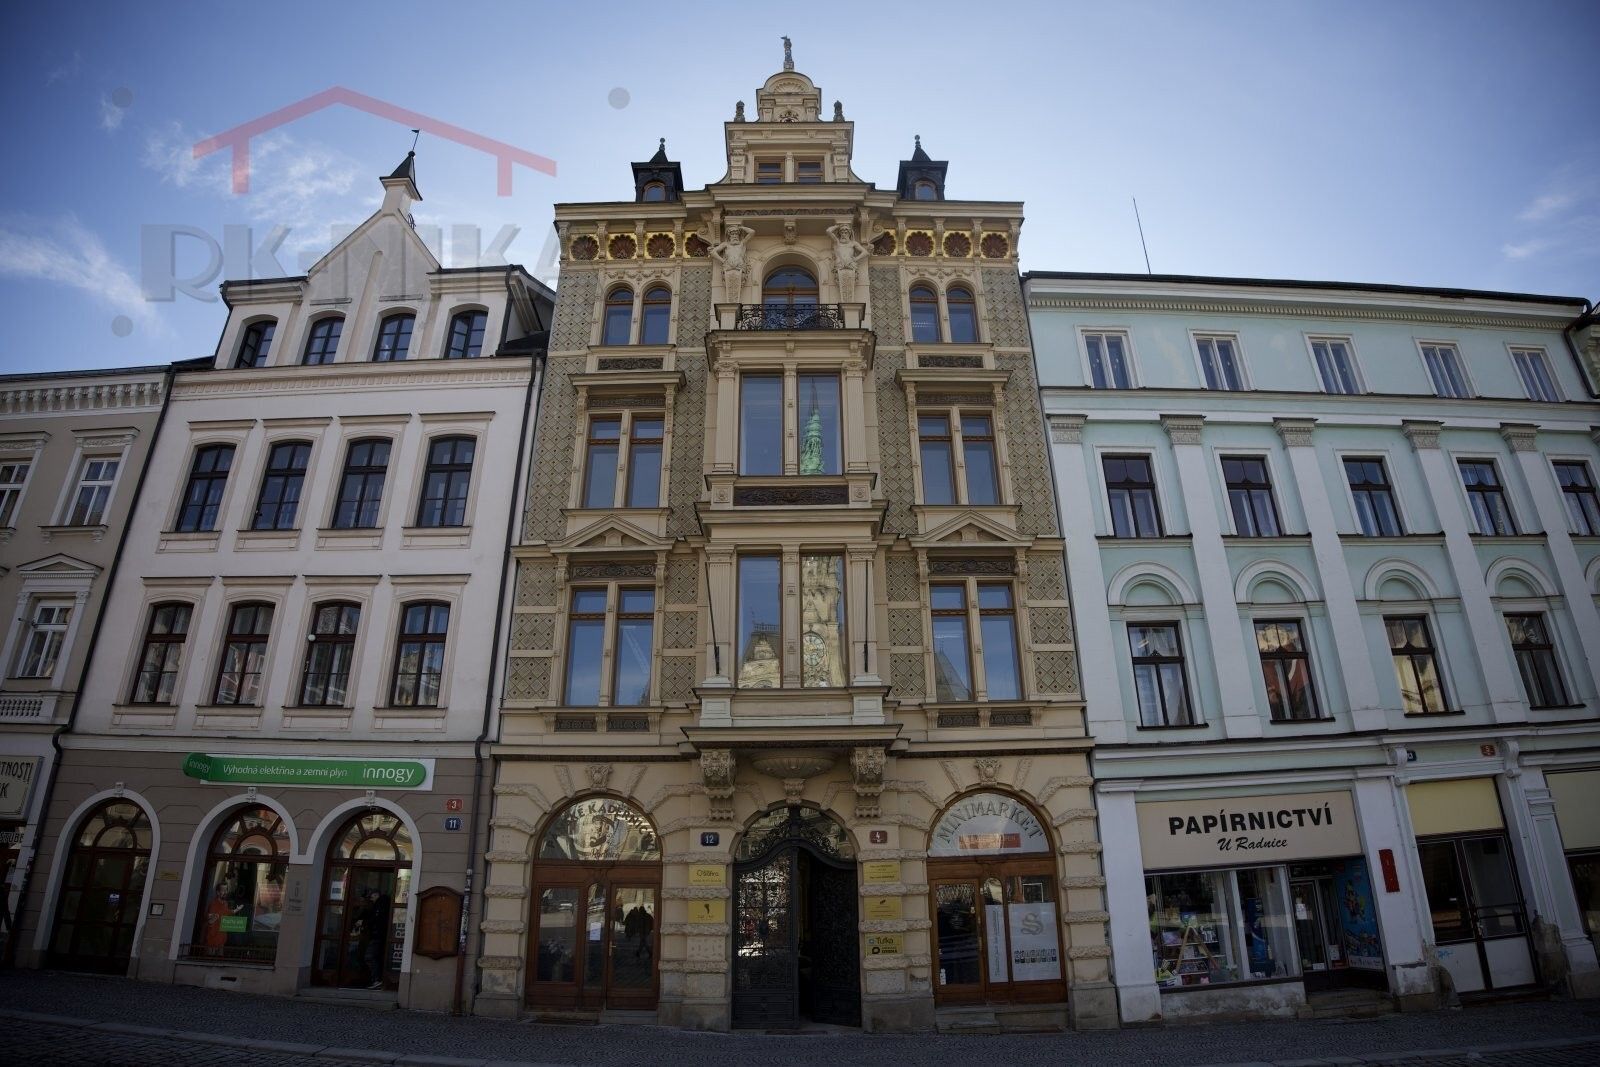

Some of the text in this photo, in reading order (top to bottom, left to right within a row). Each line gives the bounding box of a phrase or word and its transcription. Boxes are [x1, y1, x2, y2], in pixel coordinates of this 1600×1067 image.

[223, 763, 348, 778] Výhodná elektřina a zemní plyn
[362, 763, 415, 783] innogy
[451, 800, 457, 809] 3
[449, 819, 457, 829] 11
[937, 800, 1045, 844] MINIMARKET
[1168, 802, 1333, 836] PAPÍRNICTVÍ
[705, 834, 715, 844] 12
[1217, 836, 1288, 851] U Radnice
